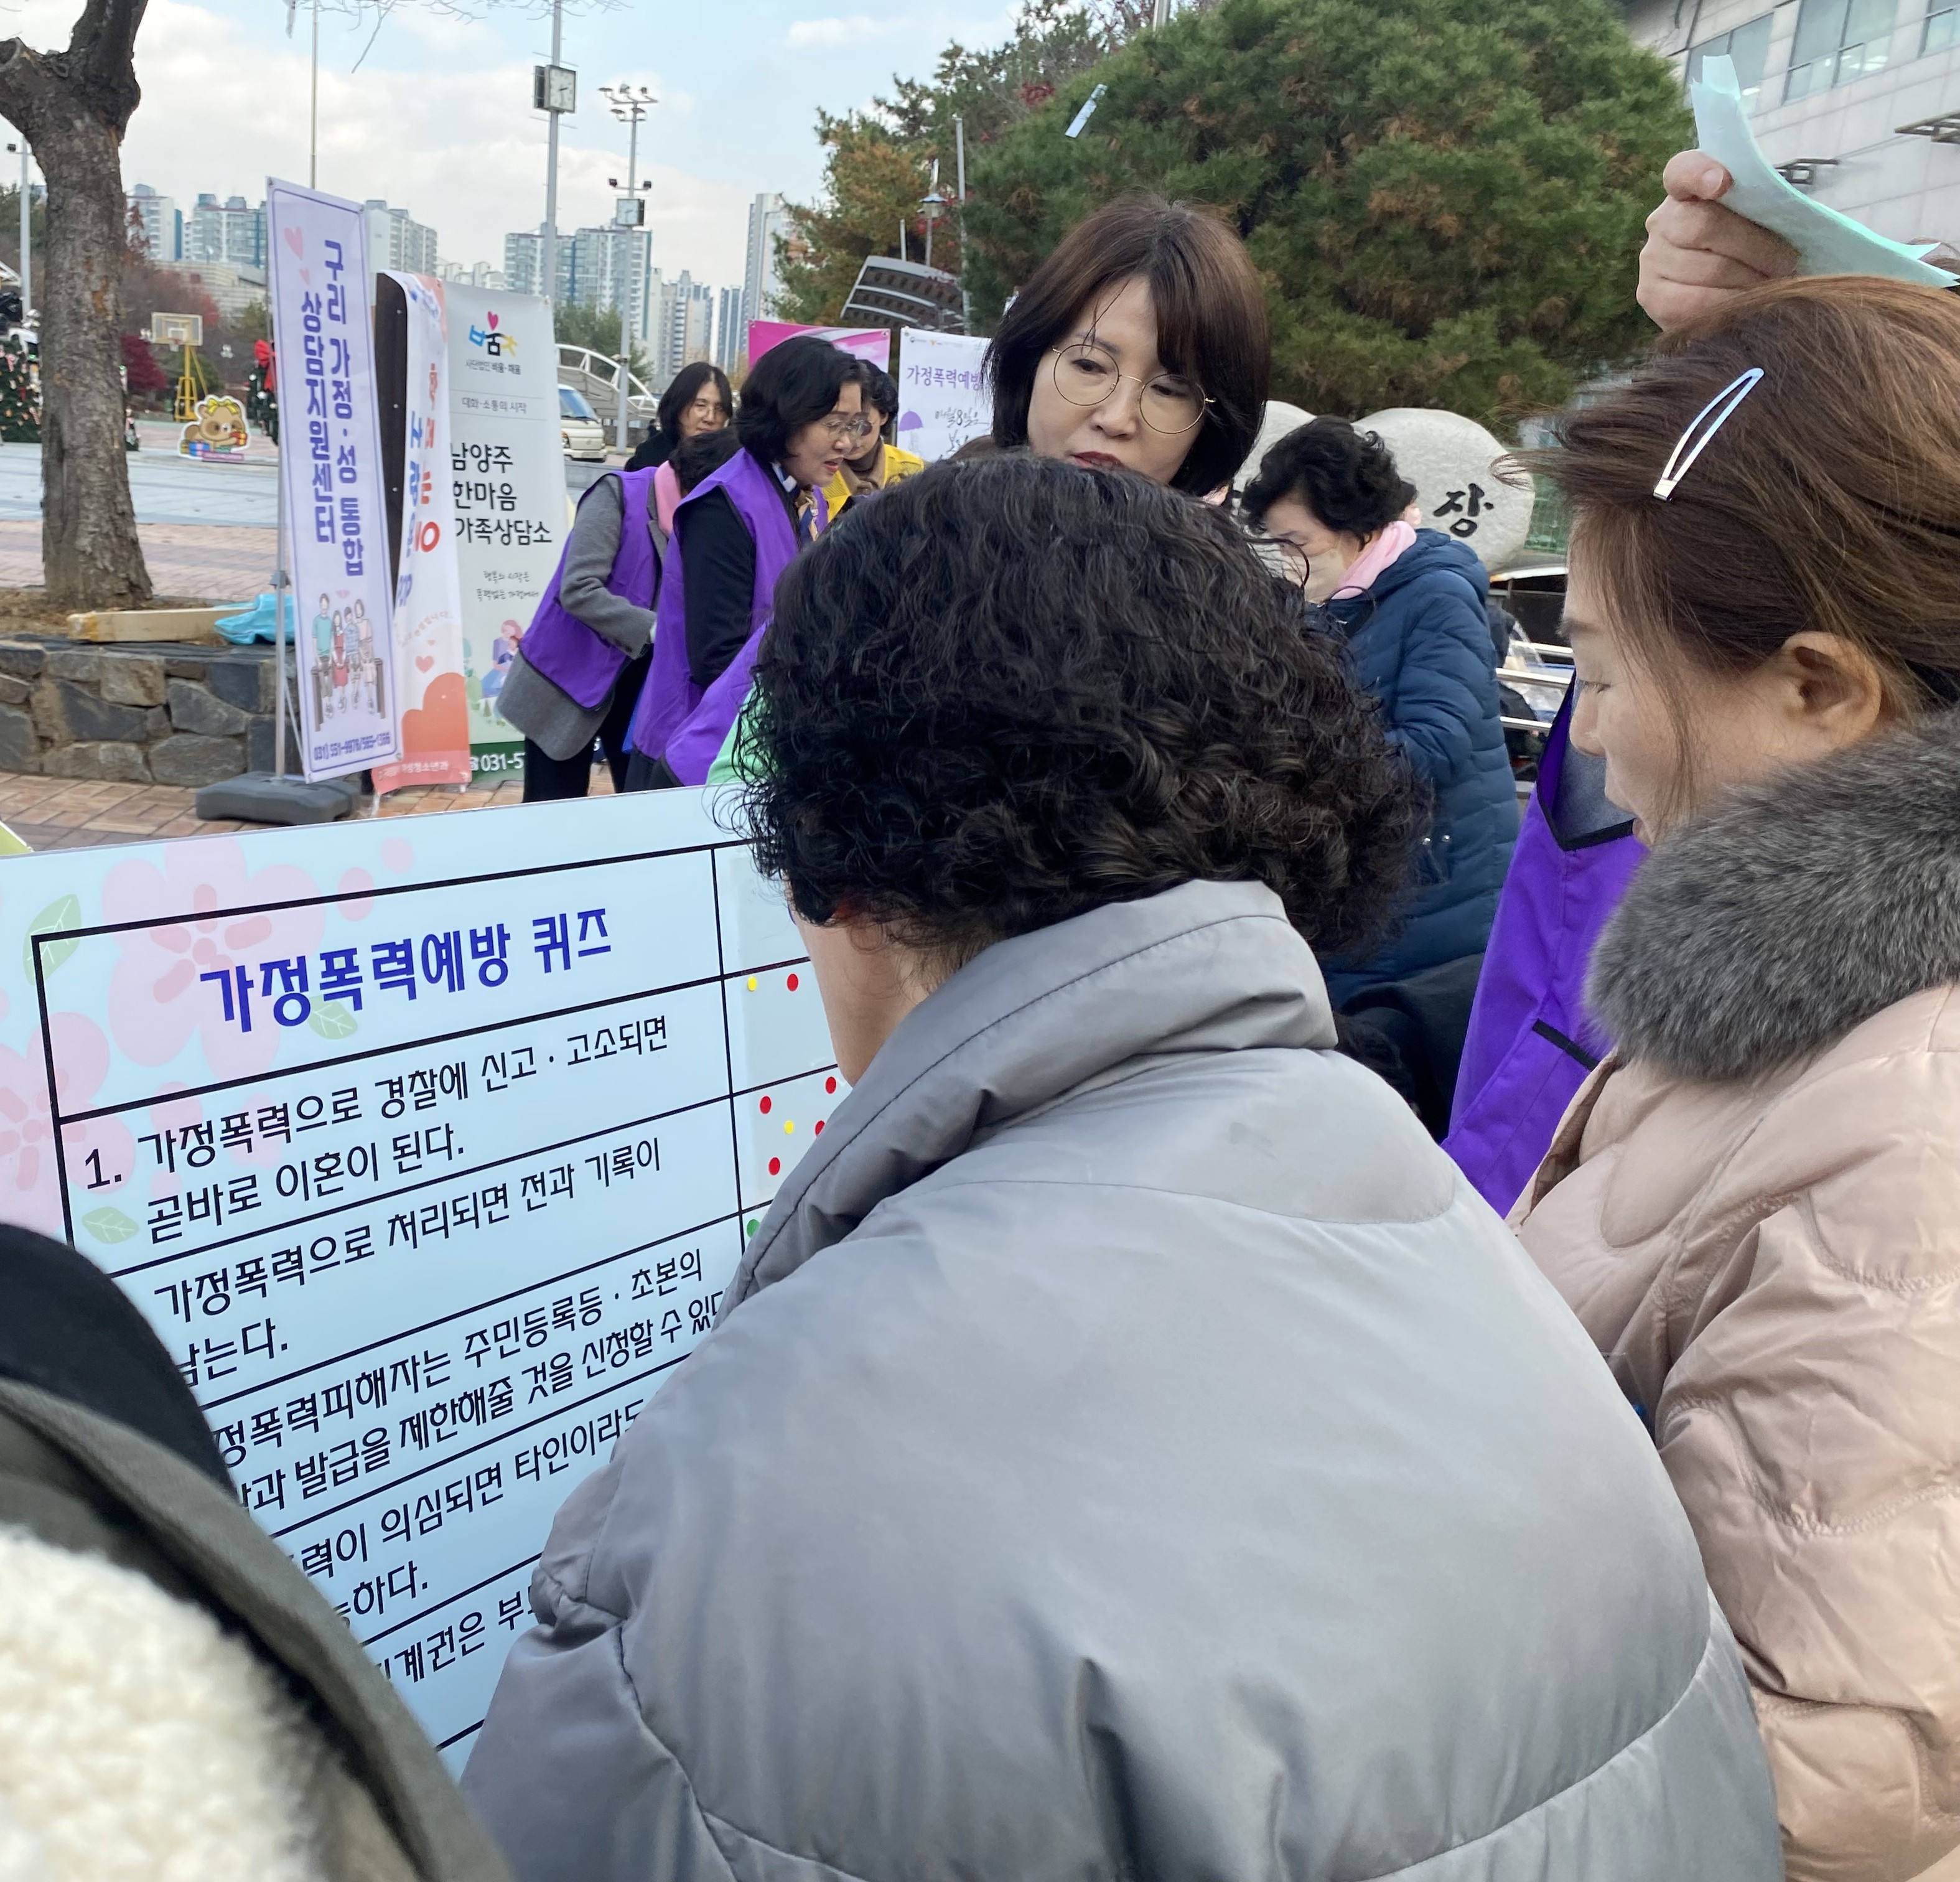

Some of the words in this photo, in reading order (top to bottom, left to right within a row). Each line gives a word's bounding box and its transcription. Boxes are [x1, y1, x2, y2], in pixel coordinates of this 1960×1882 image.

[301, 291, 336, 545] 상담지원센터
[324, 239, 347, 325] 구리
[340, 497, 364, 576] 통합
[450, 442, 513, 475] 남양주
[453, 481, 518, 512] 한마음
[455, 518, 553, 546] 가족상담소
[1433, 483, 1493, 537] 장
[200, 924, 511, 1032] 가정폭력예방
[533, 909, 612, 974] 퀴즈
[85, 1148, 122, 1189] 1.
[138, 1087, 362, 1173] 가정폭력으로
[375, 1061, 469, 1119] 경찰에
[482, 1046, 536, 1093] 신고
[567, 1015, 668, 1067] 고소되면
[147, 1174, 262, 1245] 곧바로
[276, 1142, 379, 1202] 이혼이
[392, 1123, 464, 1175] 된다.
[154, 1225, 375, 1323] 가정폭력으로
[388, 1182, 508, 1250] 처리되면
[521, 1163, 575, 1212] 전과
[584, 1137, 661, 1187] 기록이
[464, 1286, 604, 1369] 주민등록등
[632, 1248, 702, 1301] 초본의
[294, 1426, 391, 1500] 발급을
[399, 1375, 514, 1450] 제한해줄
[521, 1352, 574, 1405] 것을
[582, 1319, 654, 1379] 신청할
[661, 1309, 683, 1344] 수
[288, 1522, 368, 1580] 력이
[380, 1461, 504, 1544] 의심되면
